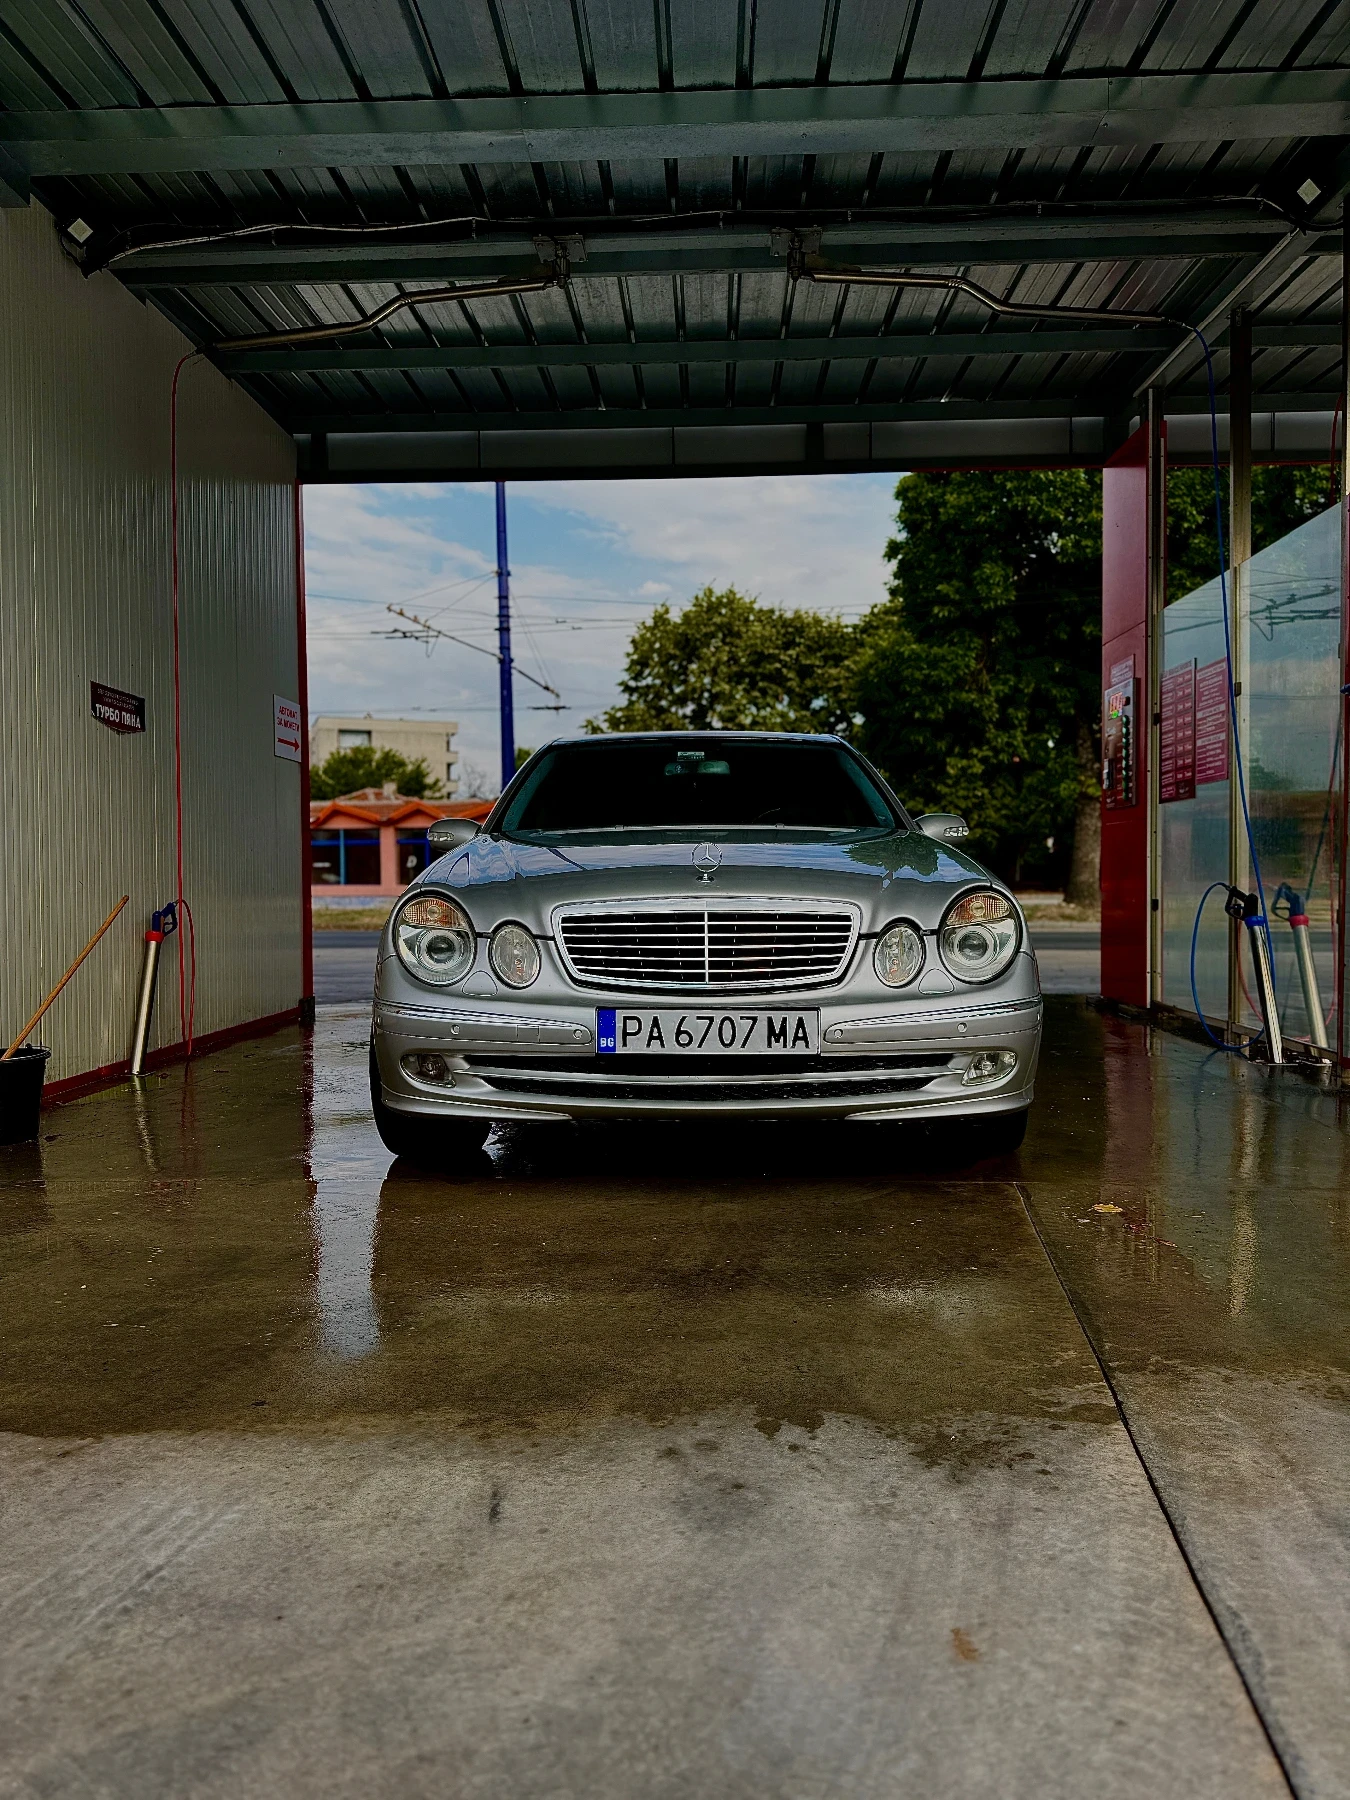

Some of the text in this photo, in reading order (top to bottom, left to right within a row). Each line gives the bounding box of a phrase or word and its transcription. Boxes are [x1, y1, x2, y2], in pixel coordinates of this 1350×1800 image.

[95, 703, 120, 723] ТУРБО
[121, 711, 141, 728] ПЯНА
[599, 1037, 615, 1048] BG
[621, 1015, 810, 1049] PA 6707 MA
